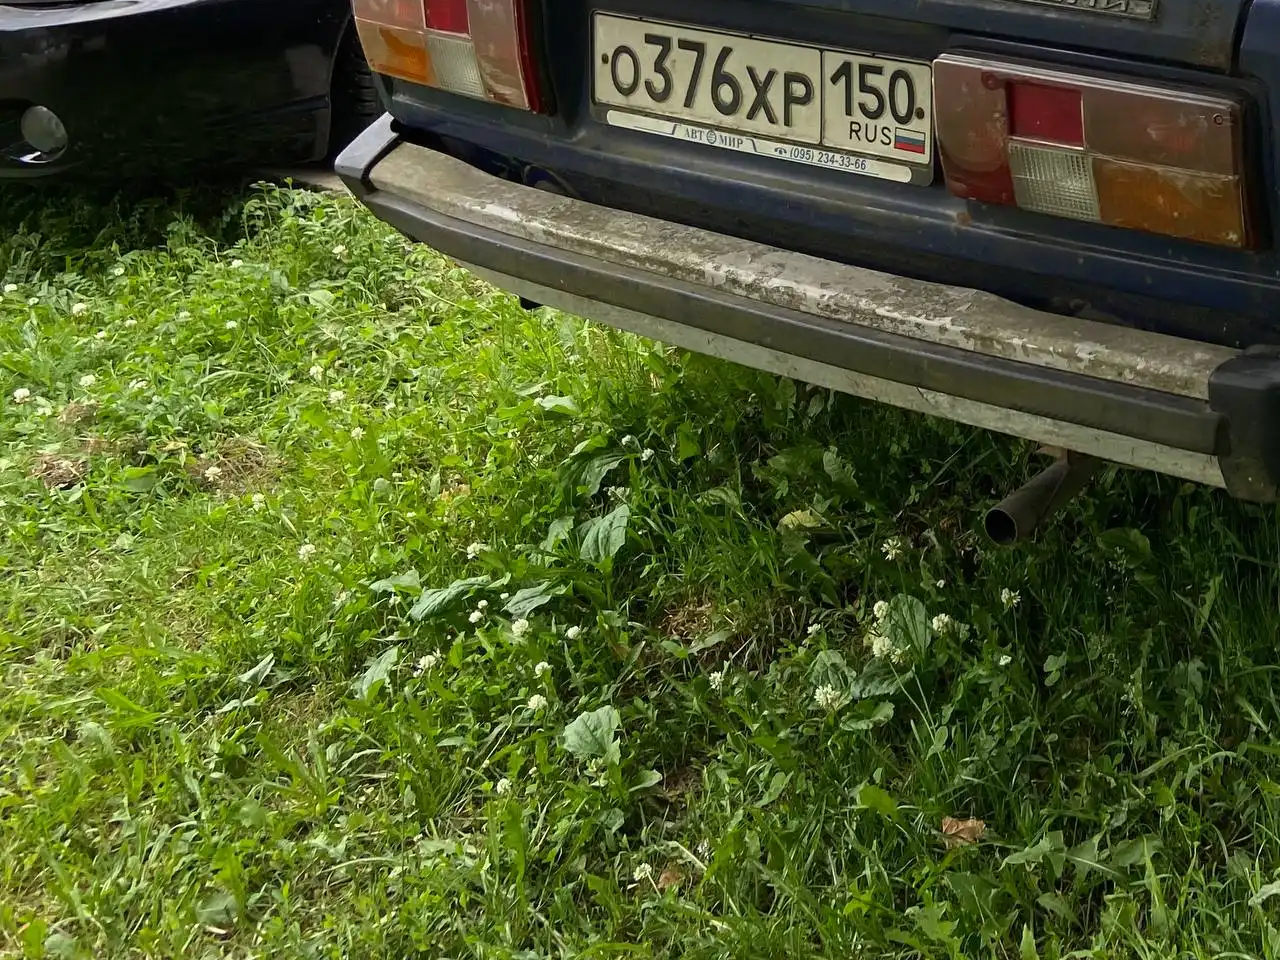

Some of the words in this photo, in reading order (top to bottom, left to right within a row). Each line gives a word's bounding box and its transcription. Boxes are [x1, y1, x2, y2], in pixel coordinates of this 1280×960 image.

[610, 33, 815, 127] О376ХР
[830, 61, 916, 125] 150
[849, 121, 892, 146] RUS
[789, 146, 815, 161] (095)
[818, 151, 867, 171] 234-33-66
